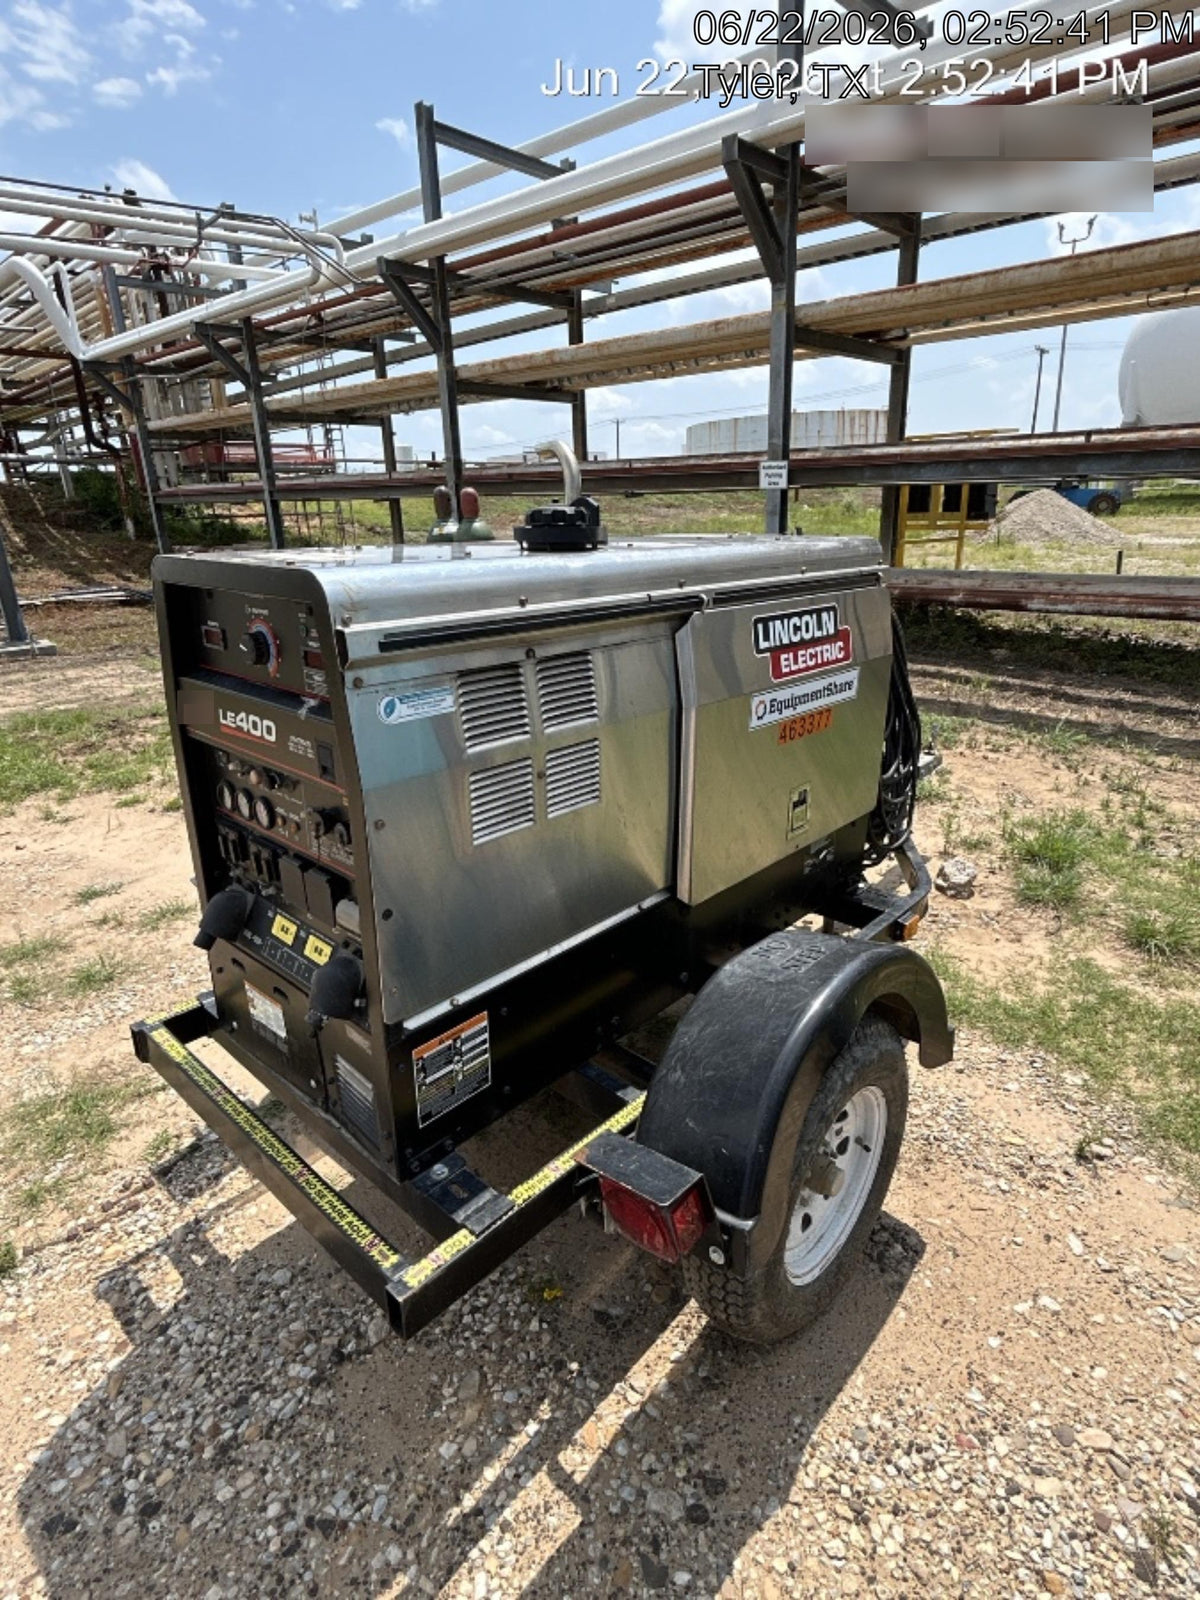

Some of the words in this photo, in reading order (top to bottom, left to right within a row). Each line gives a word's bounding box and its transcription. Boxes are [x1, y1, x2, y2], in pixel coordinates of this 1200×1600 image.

[757, 611, 836, 650] LINCOLN
[780, 641, 845, 674] ELECTRIC
[768, 679, 854, 715] EquipmentShare
[218, 708, 277, 743] LE400
[779, 709, 832, 744] 463377
